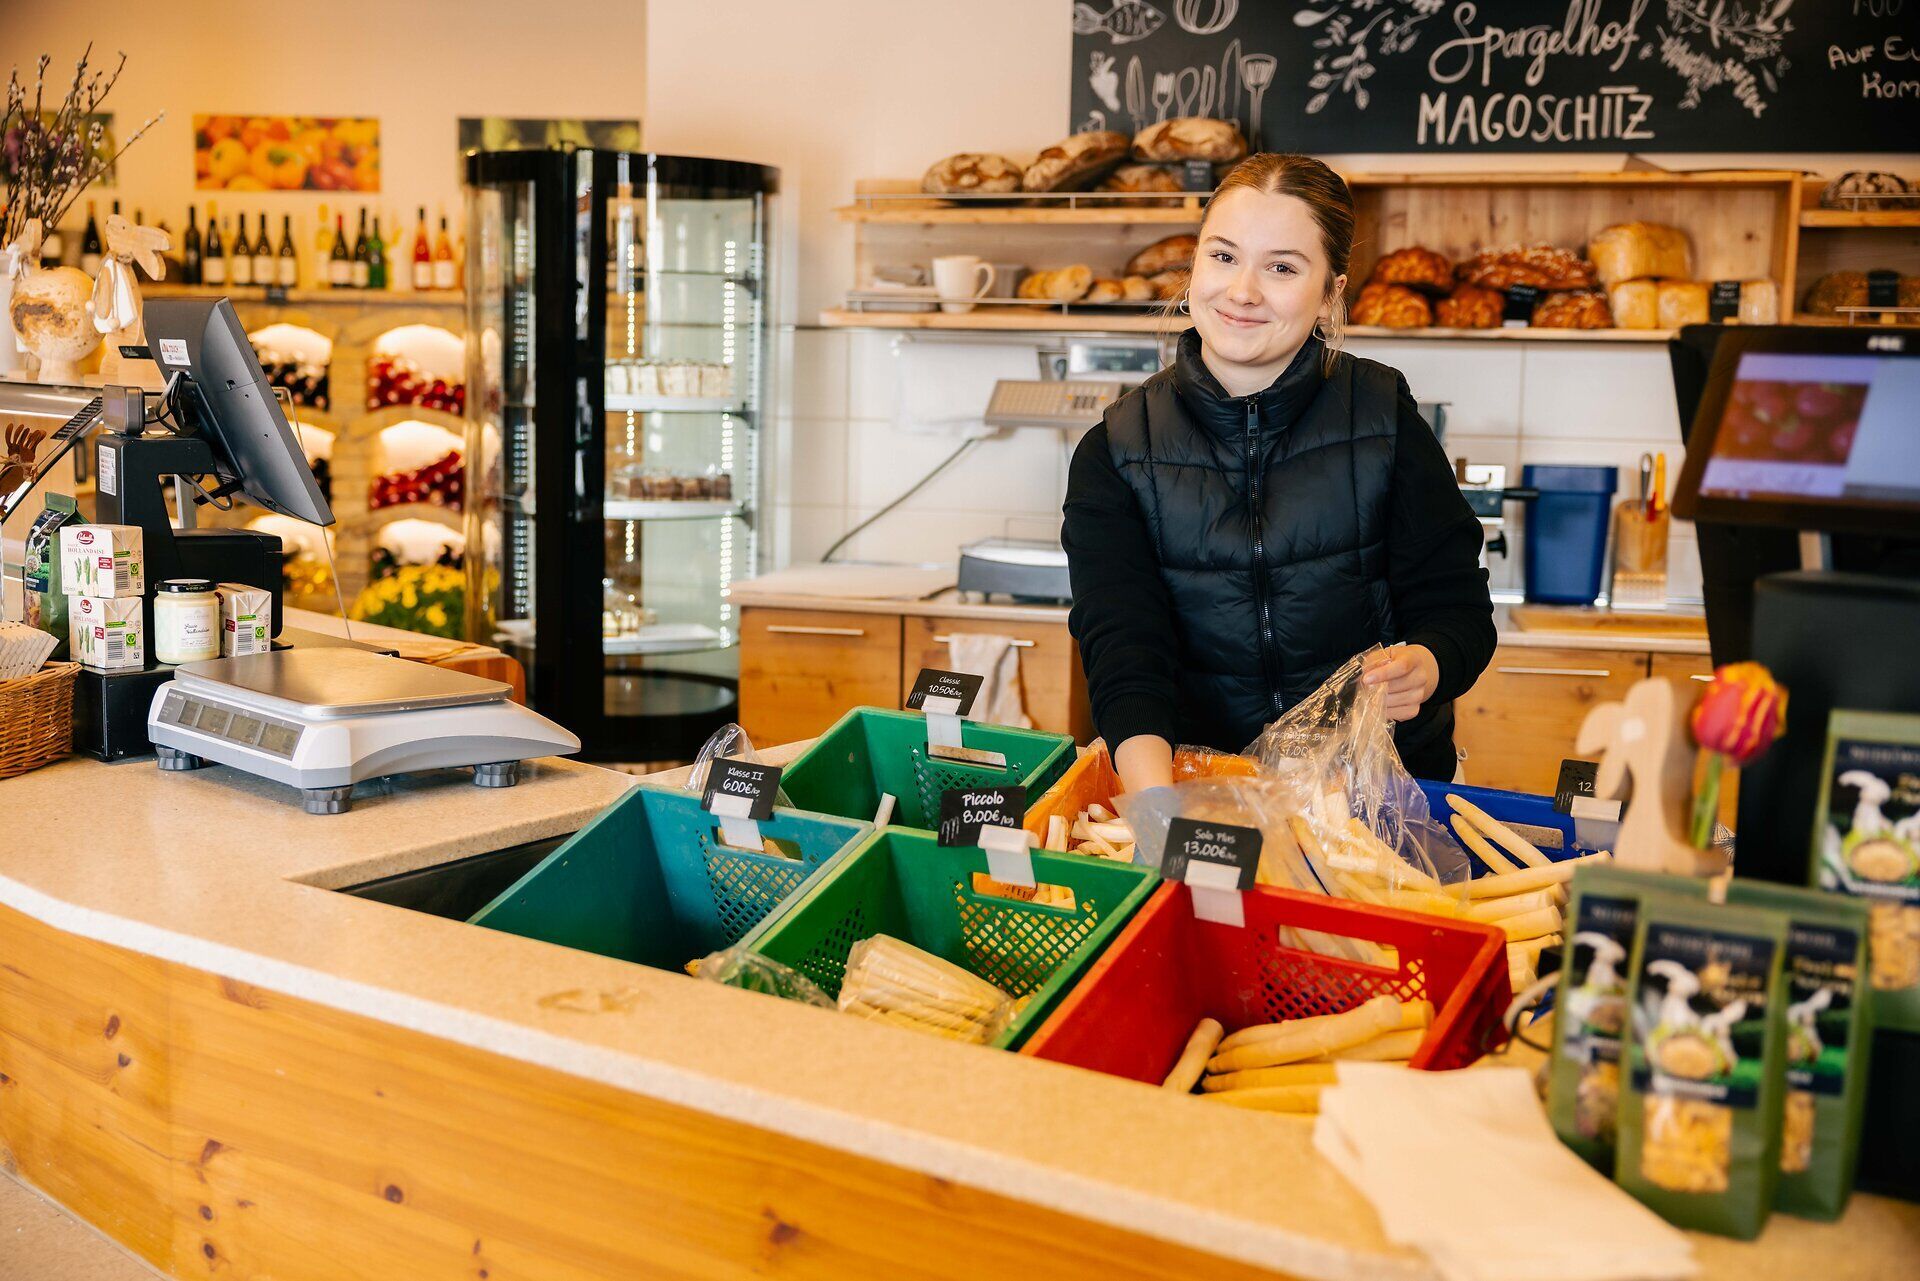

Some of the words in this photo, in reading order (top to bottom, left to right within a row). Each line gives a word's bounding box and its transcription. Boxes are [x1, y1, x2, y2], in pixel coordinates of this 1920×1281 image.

[1428, 0, 1648, 87] Spargelhof
[1417, 86, 1655, 145] MAGOSCHITZ
[939, 676, 961, 685] Classic
[727, 766, 750, 778] Klasse
[751, 771, 765, 781] II
[962, 790, 1004, 807] Piccolo
